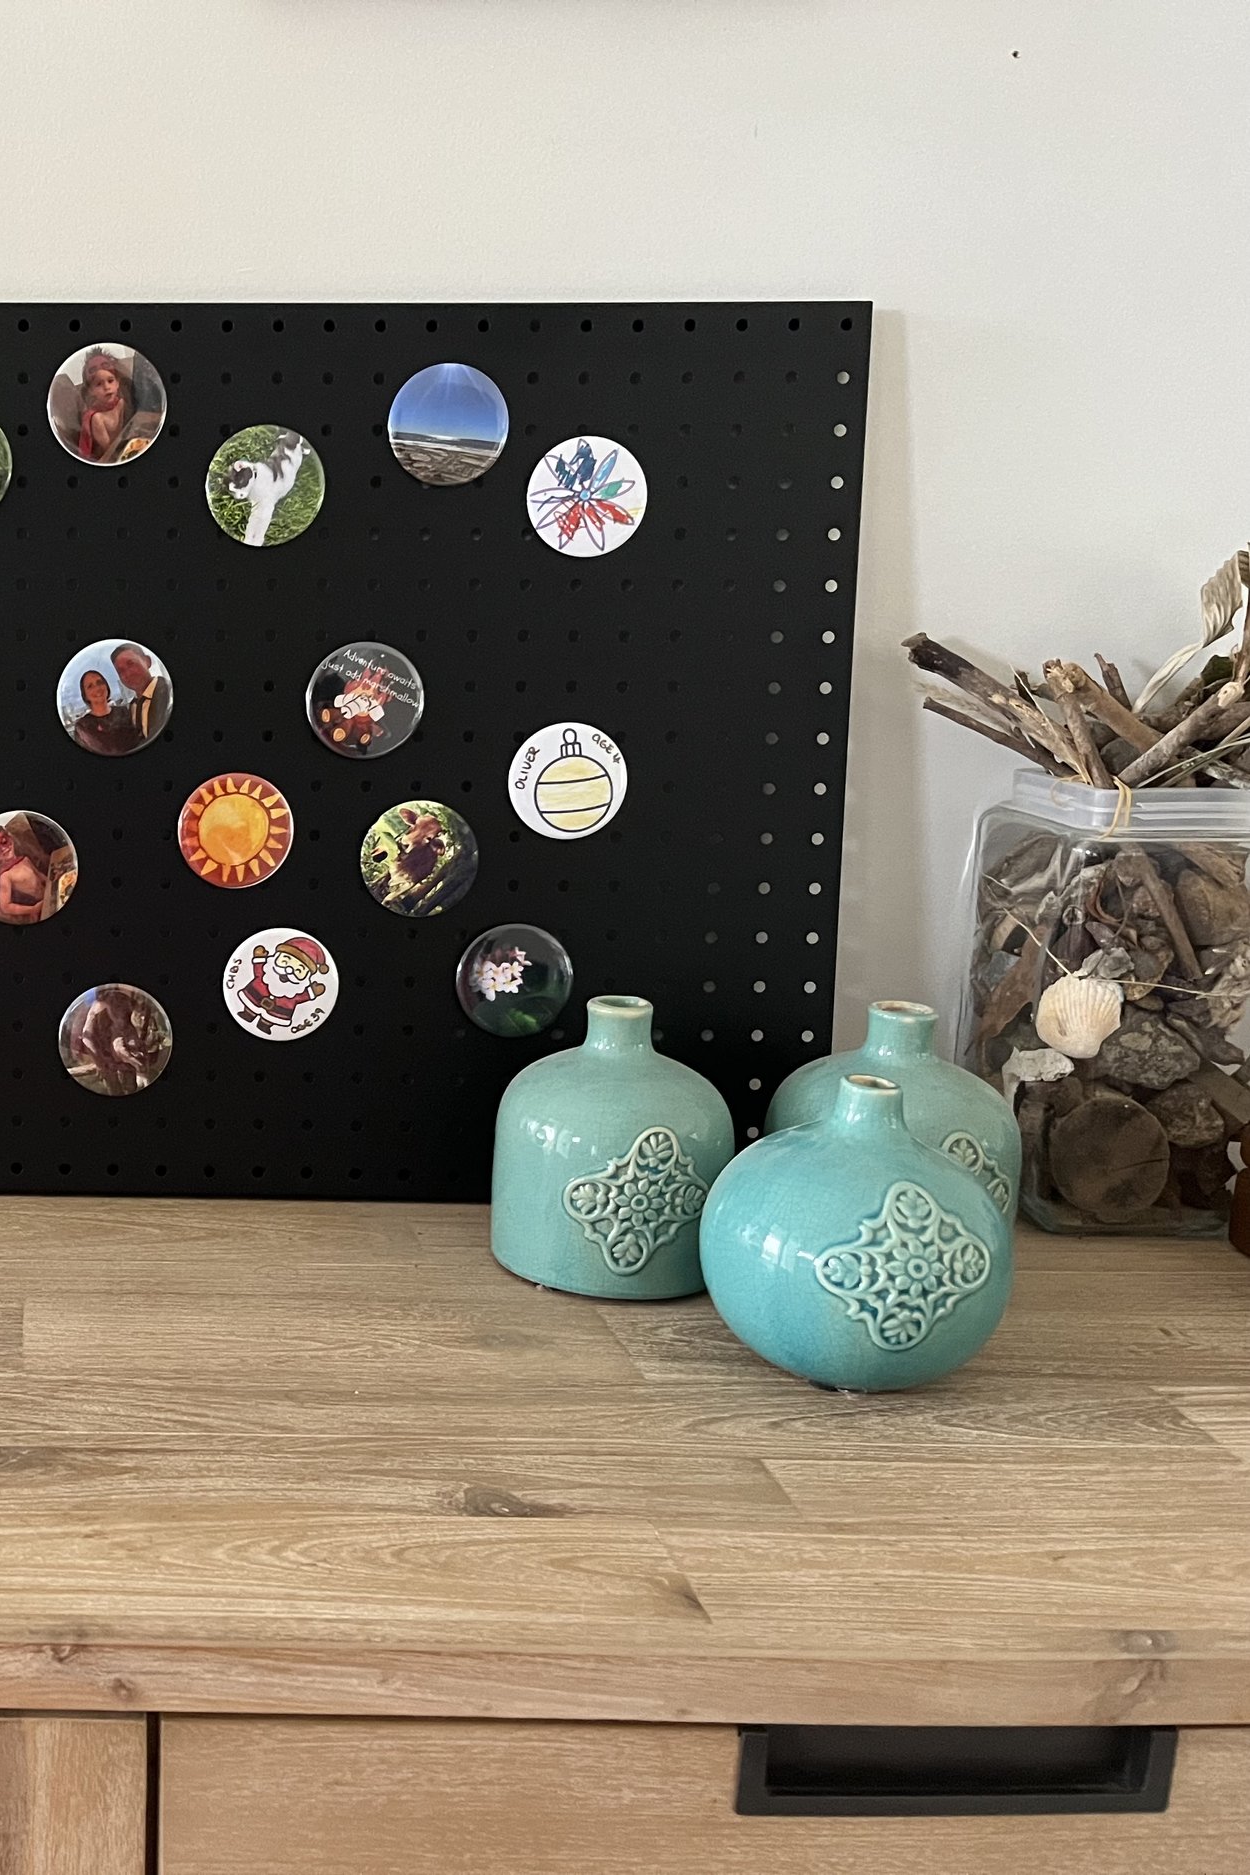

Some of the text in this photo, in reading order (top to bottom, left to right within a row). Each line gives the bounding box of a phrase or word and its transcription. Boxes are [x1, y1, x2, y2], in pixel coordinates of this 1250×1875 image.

[343, 649, 417, 690] Adventure awaits
[345, 670, 361, 681] add
[612, 752, 622, 765] 4
[514, 746, 541, 790] OLIVER
[310, 1007, 326, 1022] 39
